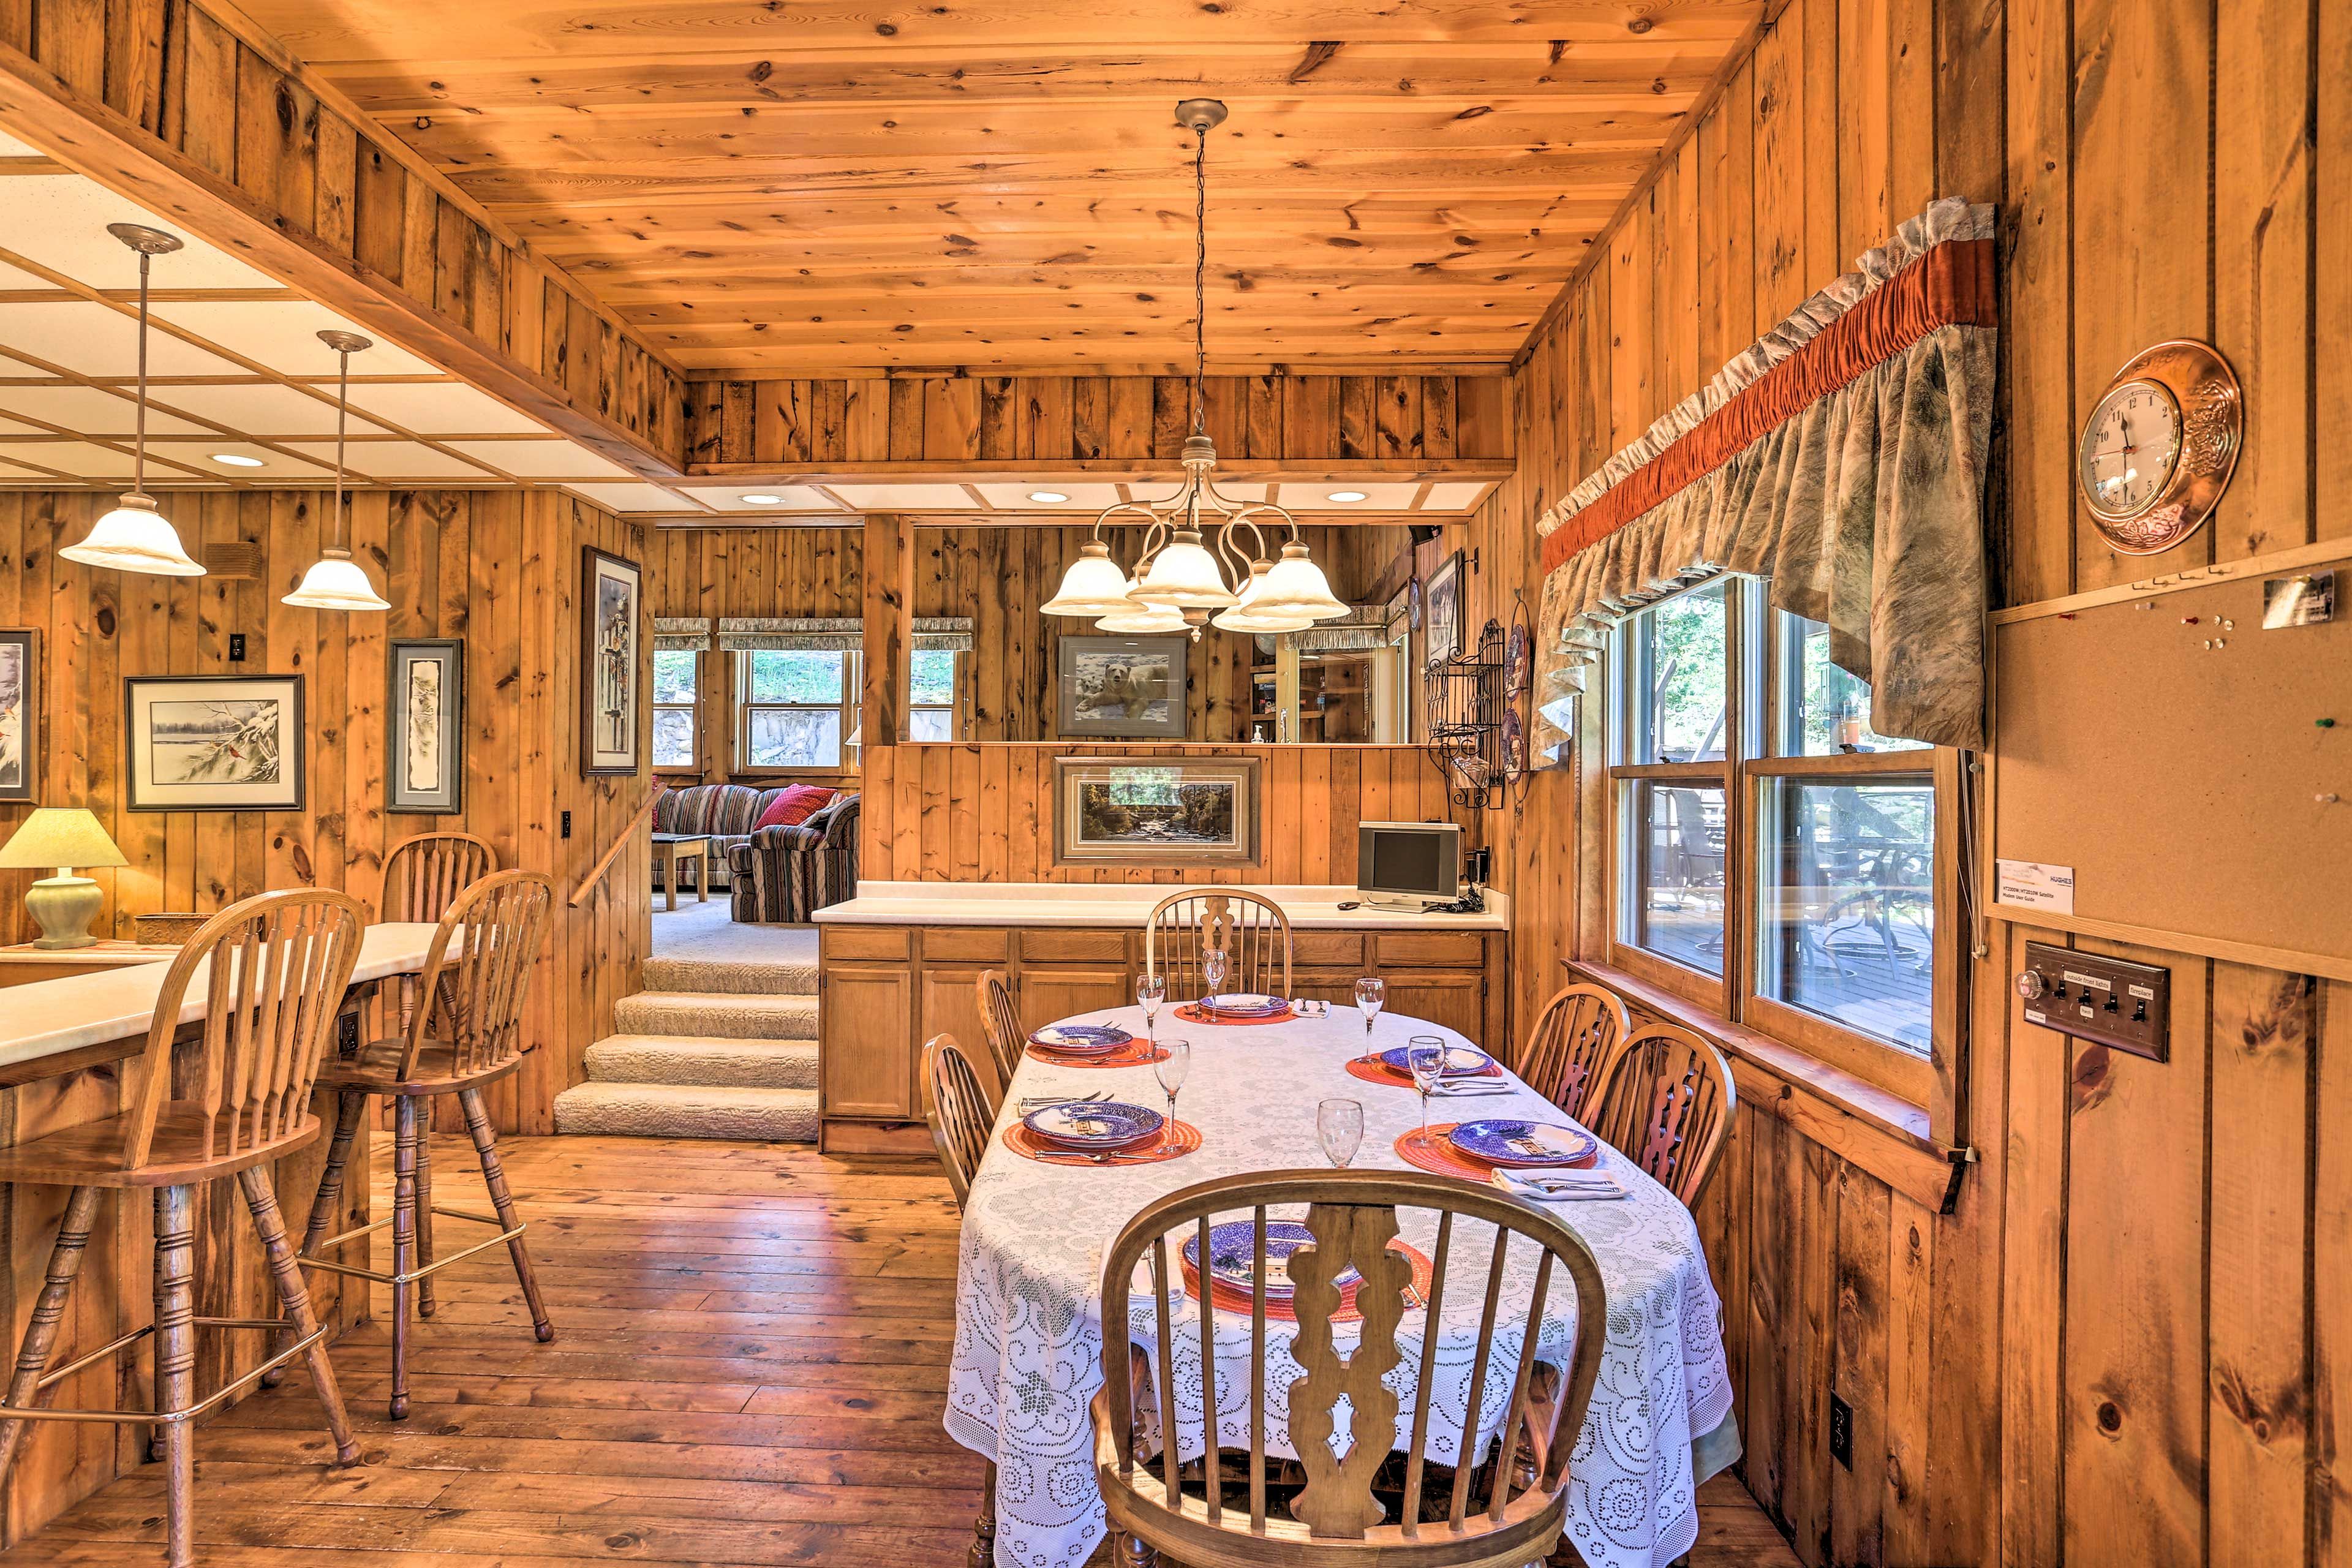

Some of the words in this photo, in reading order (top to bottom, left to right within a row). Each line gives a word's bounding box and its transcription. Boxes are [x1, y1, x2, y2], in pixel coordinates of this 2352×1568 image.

[2128, 398, 2136, 409] 12
[2149, 395, 2153, 407] 1
[2112, 411, 2120, 423] 11
[2162, 406, 2168, 418] 2
[2100, 431, 2109, 443] 10
[2095, 457, 2100, 466] 9
[2162, 458, 2168, 469] 4
[2147, 480, 2152, 491] 5
[2113, 491, 2118, 502] 7
[2131, 490, 2136, 500] 6
[2095, 980, 2108, 989] lights
[2130, 987, 2151, 997] fireplace
